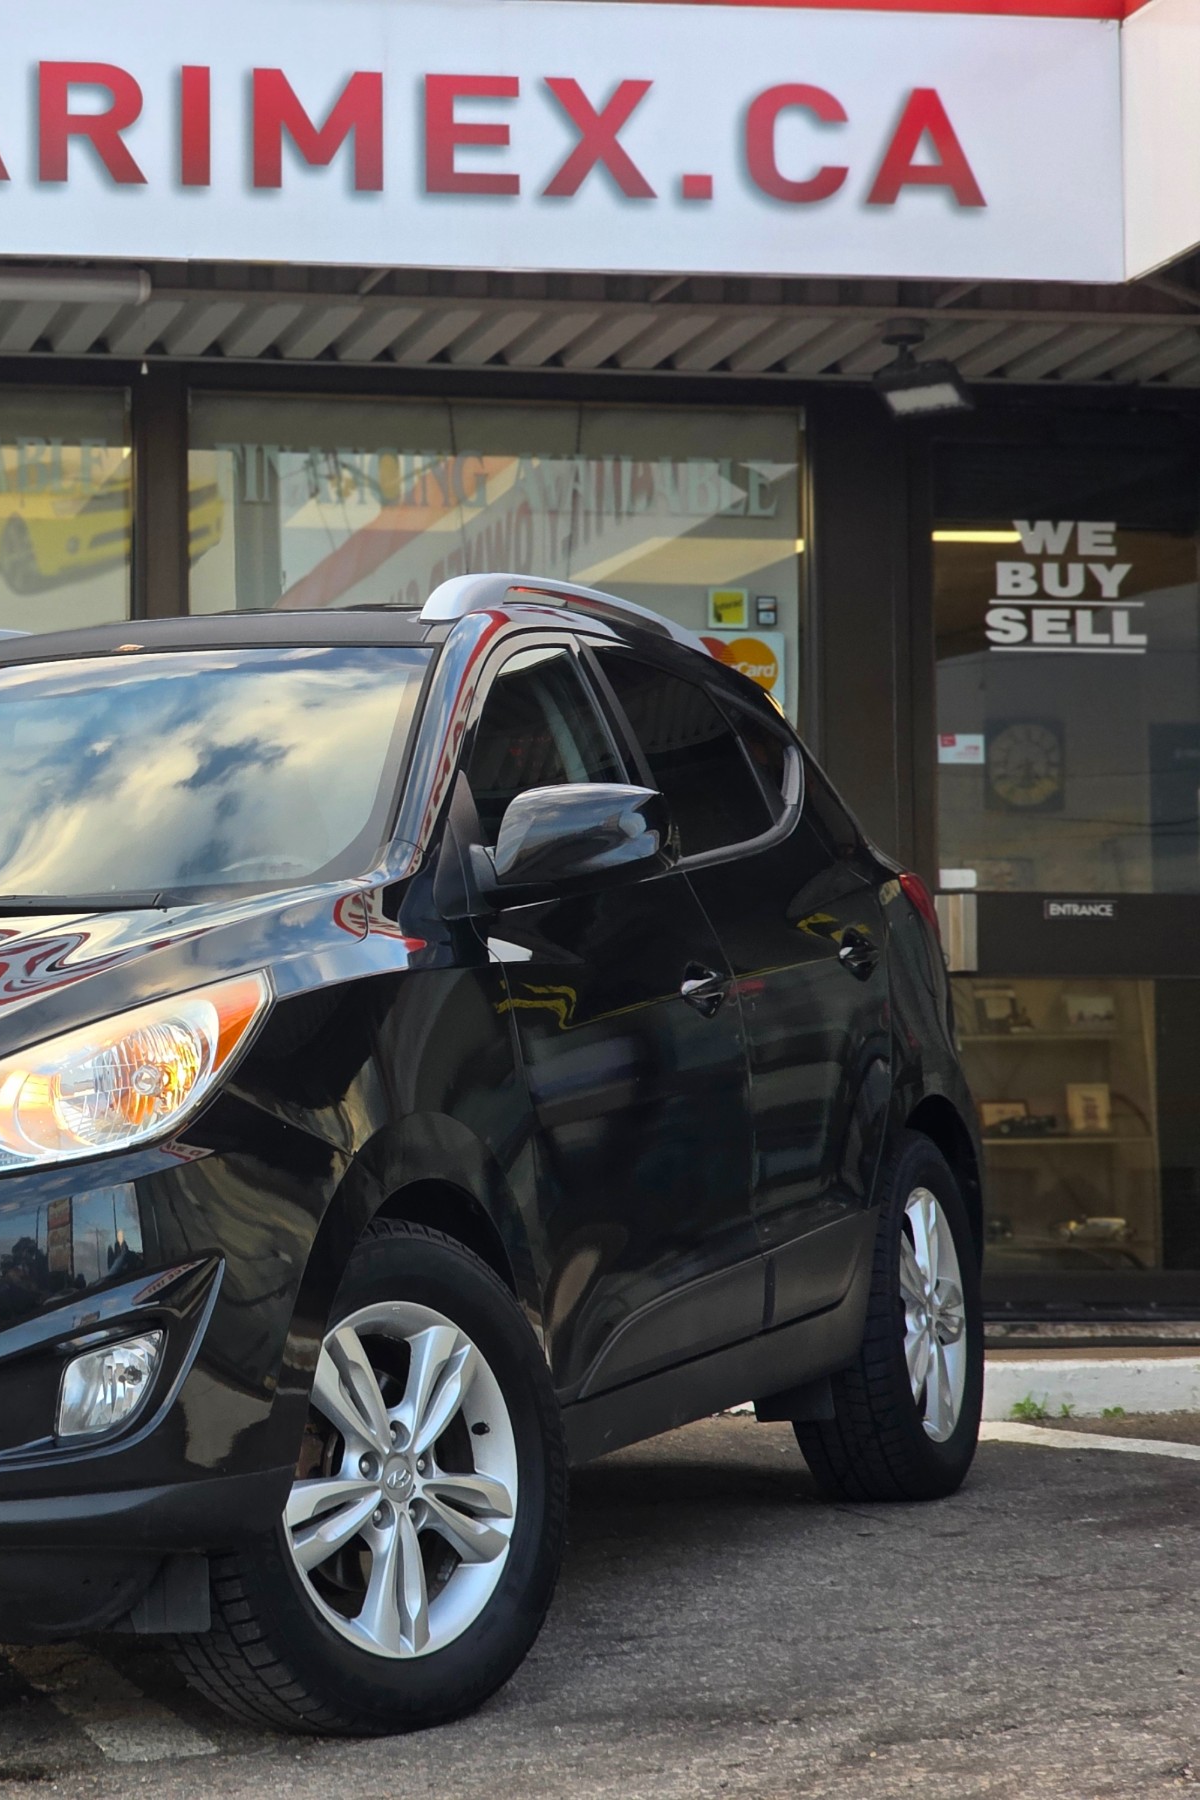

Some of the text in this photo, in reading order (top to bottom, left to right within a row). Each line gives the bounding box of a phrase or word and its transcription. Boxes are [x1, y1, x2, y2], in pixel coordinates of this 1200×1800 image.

[1012, 520, 1117, 556] WE
[996, 561, 1133, 598] BUY
[985, 607, 1147, 645] SELL
[1049, 903, 1114, 917] ENTRANCE
